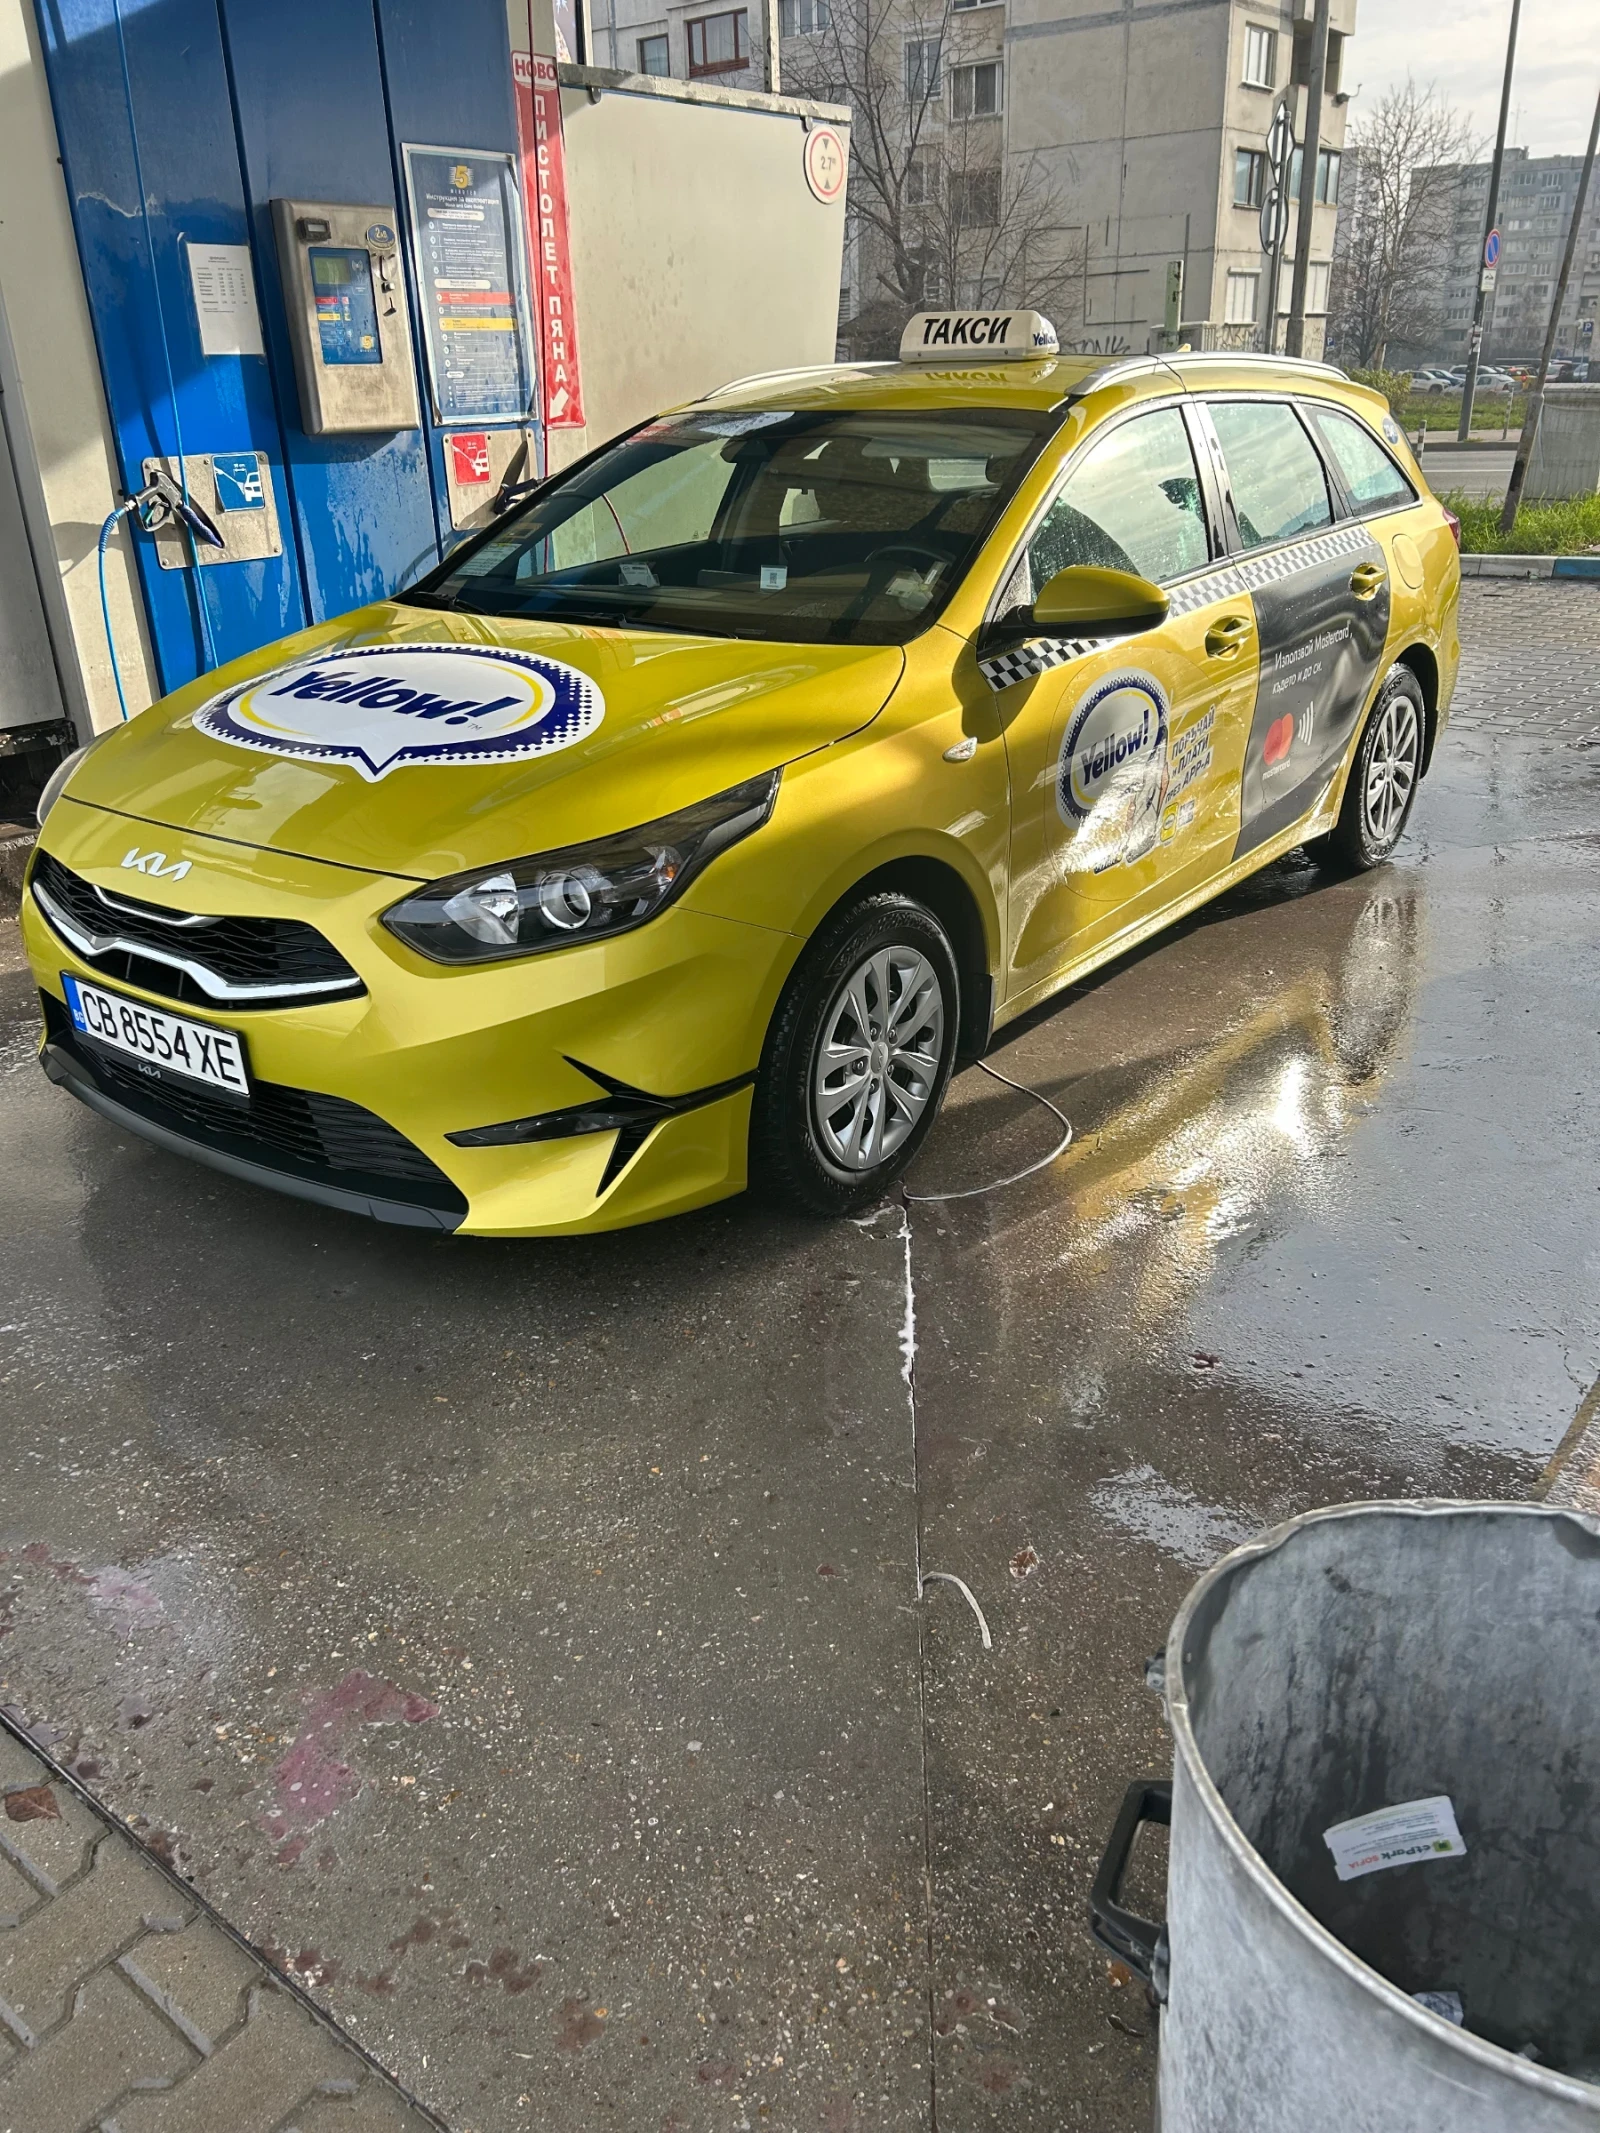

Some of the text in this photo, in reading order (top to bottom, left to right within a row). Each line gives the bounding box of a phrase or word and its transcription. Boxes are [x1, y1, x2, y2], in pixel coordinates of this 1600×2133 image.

[514, 58, 557, 80] НОВО
[454, 165, 468, 189] 5
[534, 95, 568, 383] ПИСТОЛЕТ ПЯНА
[922, 317, 1012, 345] ТАКСИ
[1032, 332, 1056, 346] Yello
[1274, 640, 1313, 670] Използвай
[1272, 674, 1297, 695] където
[1302, 665, 1312, 682] да
[267, 670, 525, 726] Yellow!
[1080, 709, 1149, 786] Yellow!
[1172, 706, 1216, 760] ПОРЪЧАЙ
[1178, 735, 1209, 773] ПЛАТИ
[1262, 758, 1291, 781] mastercard
[121, 848, 193, 882] KIA
[74, 1009, 85, 1024] BG
[81, 990, 242, 1086] CB 8554 XE
[1348, 1855, 1379, 1869] SOFIA
